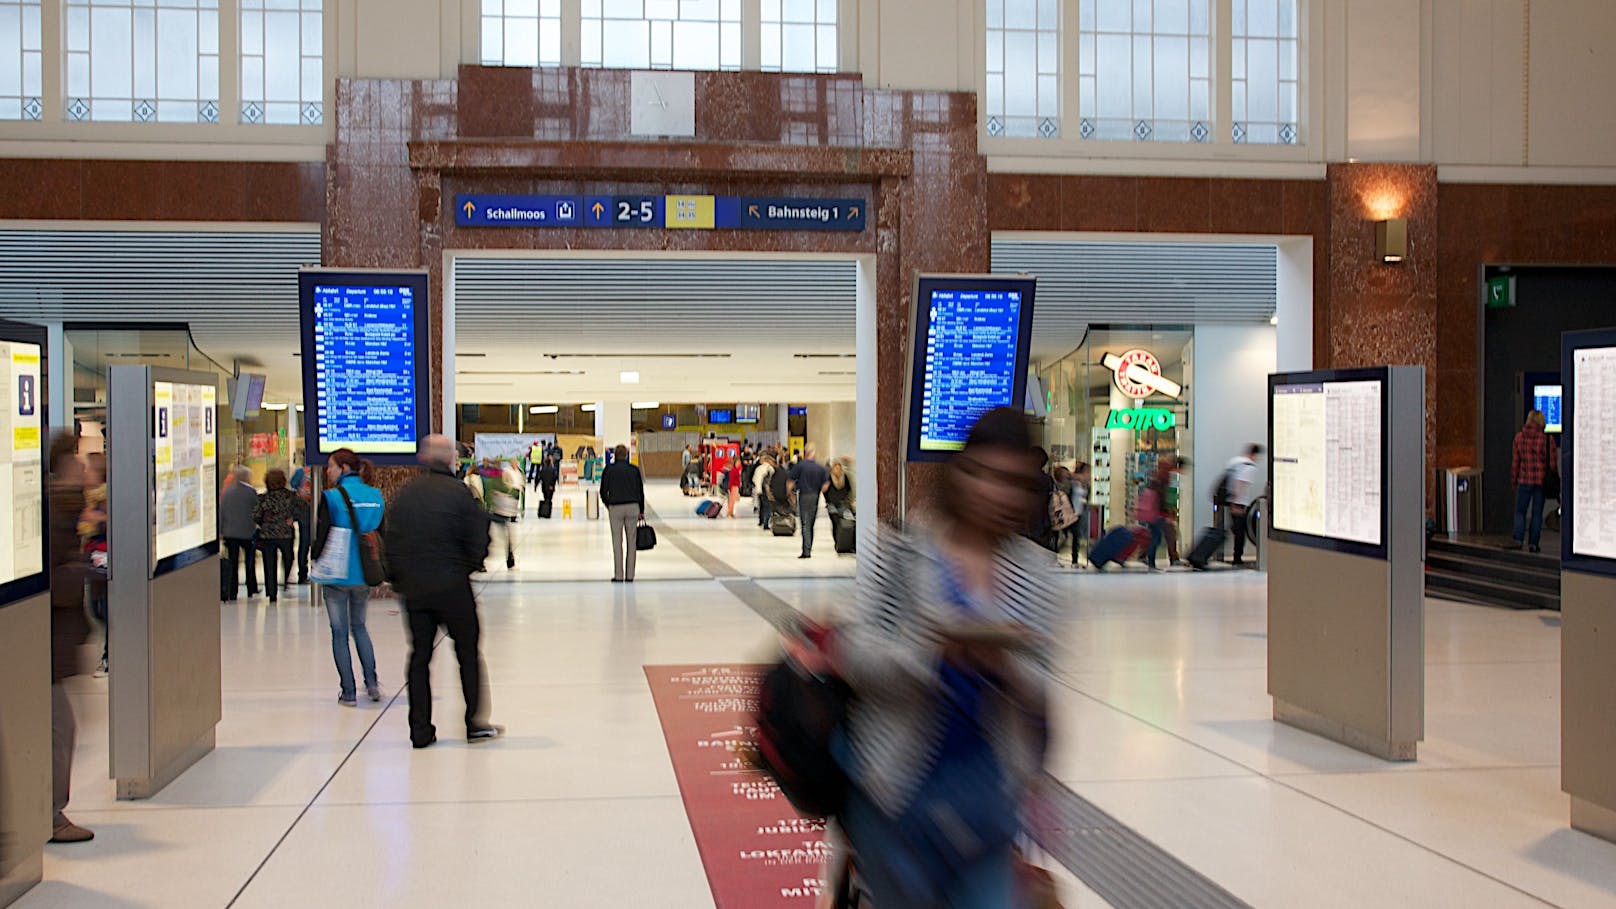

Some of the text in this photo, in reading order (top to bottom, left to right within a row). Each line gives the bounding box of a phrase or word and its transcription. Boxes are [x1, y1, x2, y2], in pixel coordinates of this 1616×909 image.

[486, 208, 545, 220] Schallmoos
[617, 201, 653, 222] 2-5
[768, 205, 839, 222] Bahnsteig 1
[1105, 407, 1175, 431] LOTTO
